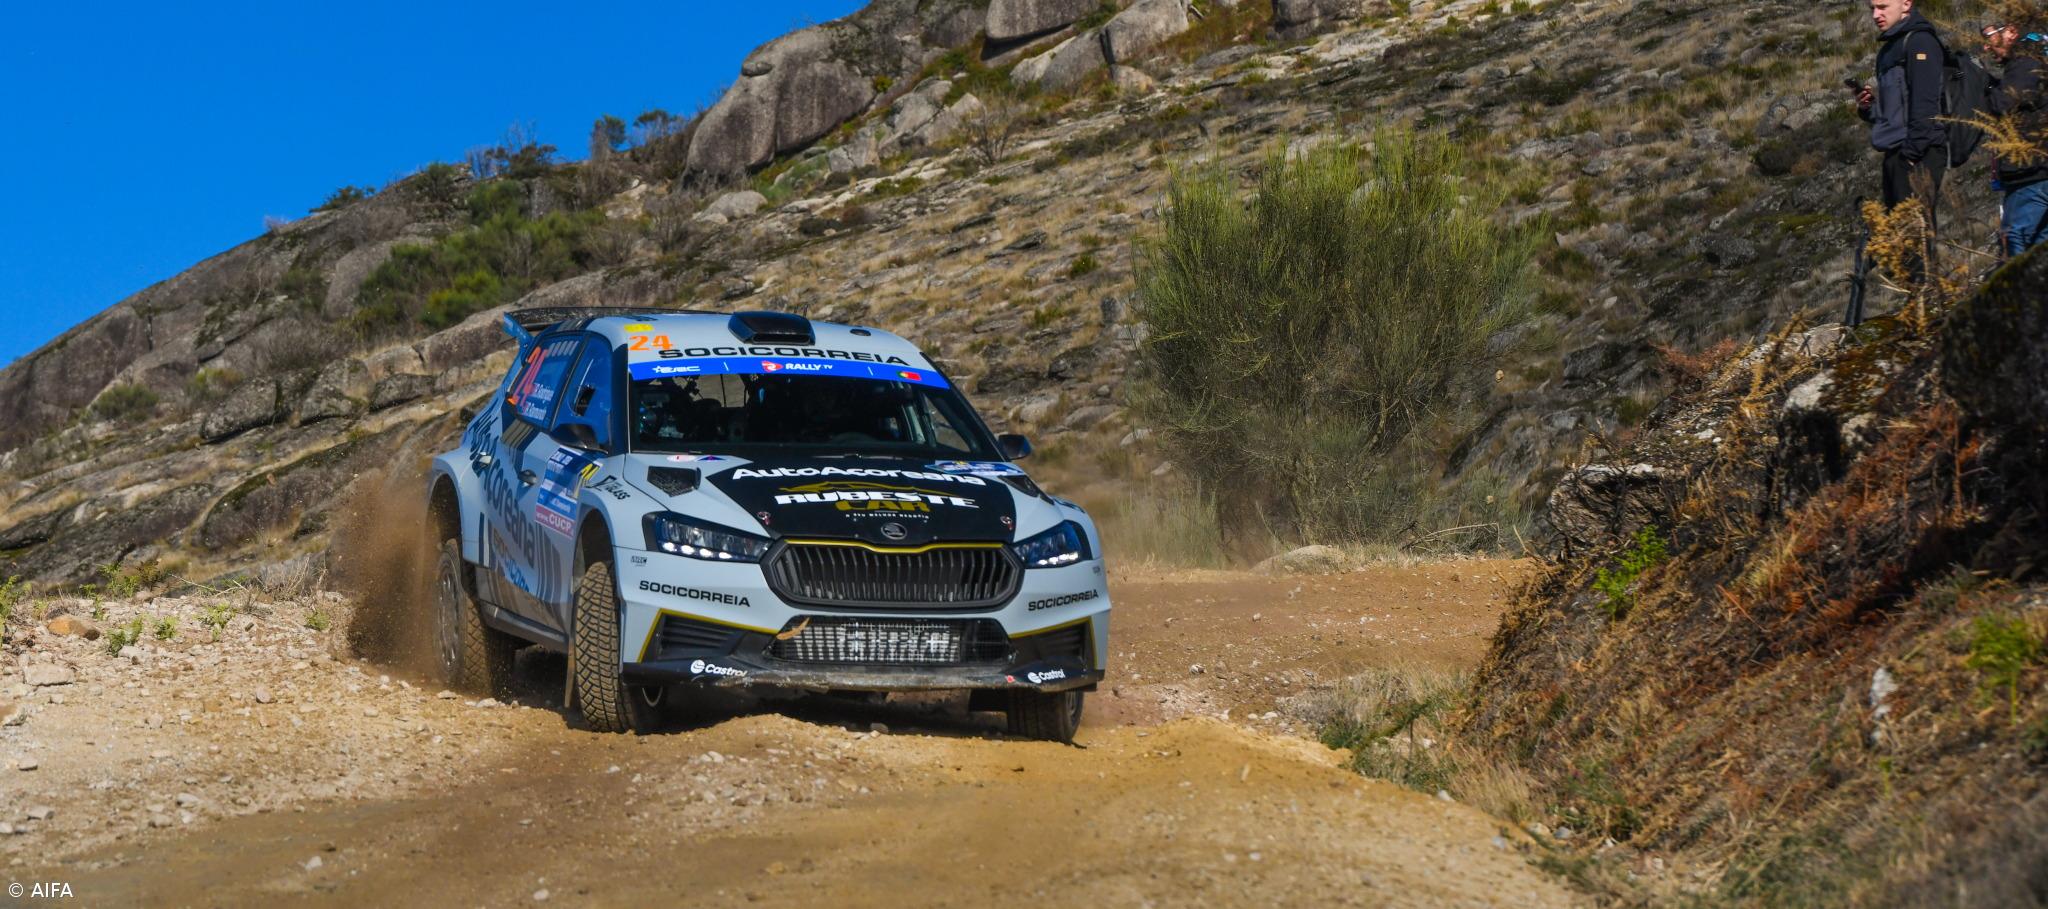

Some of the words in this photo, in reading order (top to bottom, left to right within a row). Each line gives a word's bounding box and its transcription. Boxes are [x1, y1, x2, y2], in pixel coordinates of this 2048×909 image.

[629, 335, 673, 350] 24
[658, 347, 910, 366] SOCICORREIA
[785, 363, 821, 371] RALLY
[733, 466, 986, 486] AutoAçoreana
[774, 490, 980, 508] RUBESTE
[835, 499, 931, 512] CAR
[639, 580, 750, 607] SOCICORREIA
[1028, 589, 1099, 611] SOCICORREIA
[704, 663, 748, 677] Castrol
[1039, 668, 1065, 682] Castrol
